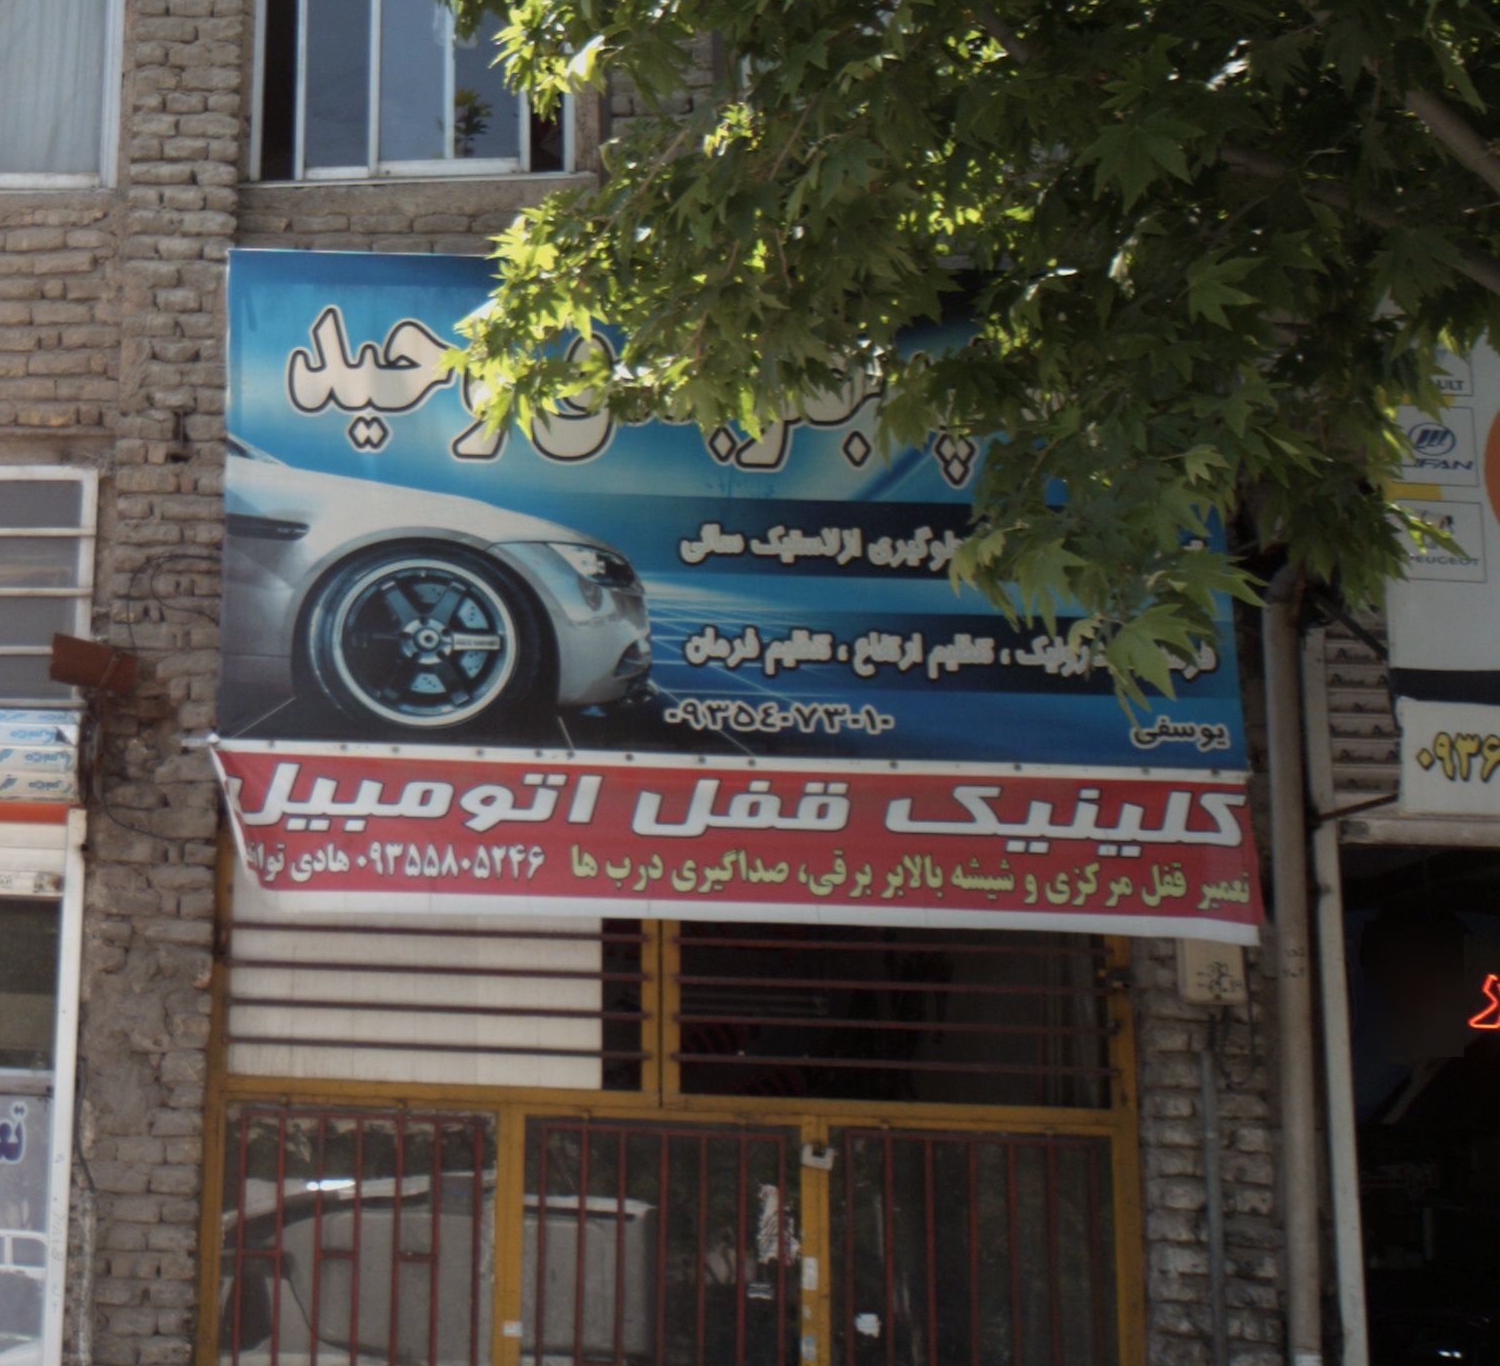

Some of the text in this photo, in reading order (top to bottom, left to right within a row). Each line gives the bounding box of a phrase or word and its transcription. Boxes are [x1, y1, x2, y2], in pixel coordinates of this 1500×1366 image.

[1410, 554, 1480, 567] EUGEOT
[227, 761, 1247, 858] کلینیک قفل اتومبیل
[289, 841, 351, 882] هادی
[951, 857, 1016, 900] شیشه
[1023, 873, 1038, 904] و
[1044, 861, 1134, 907] مرکزی
[1140, 861, 1188, 907] قفل
[1197, 869, 1250, 910] تعمیر
